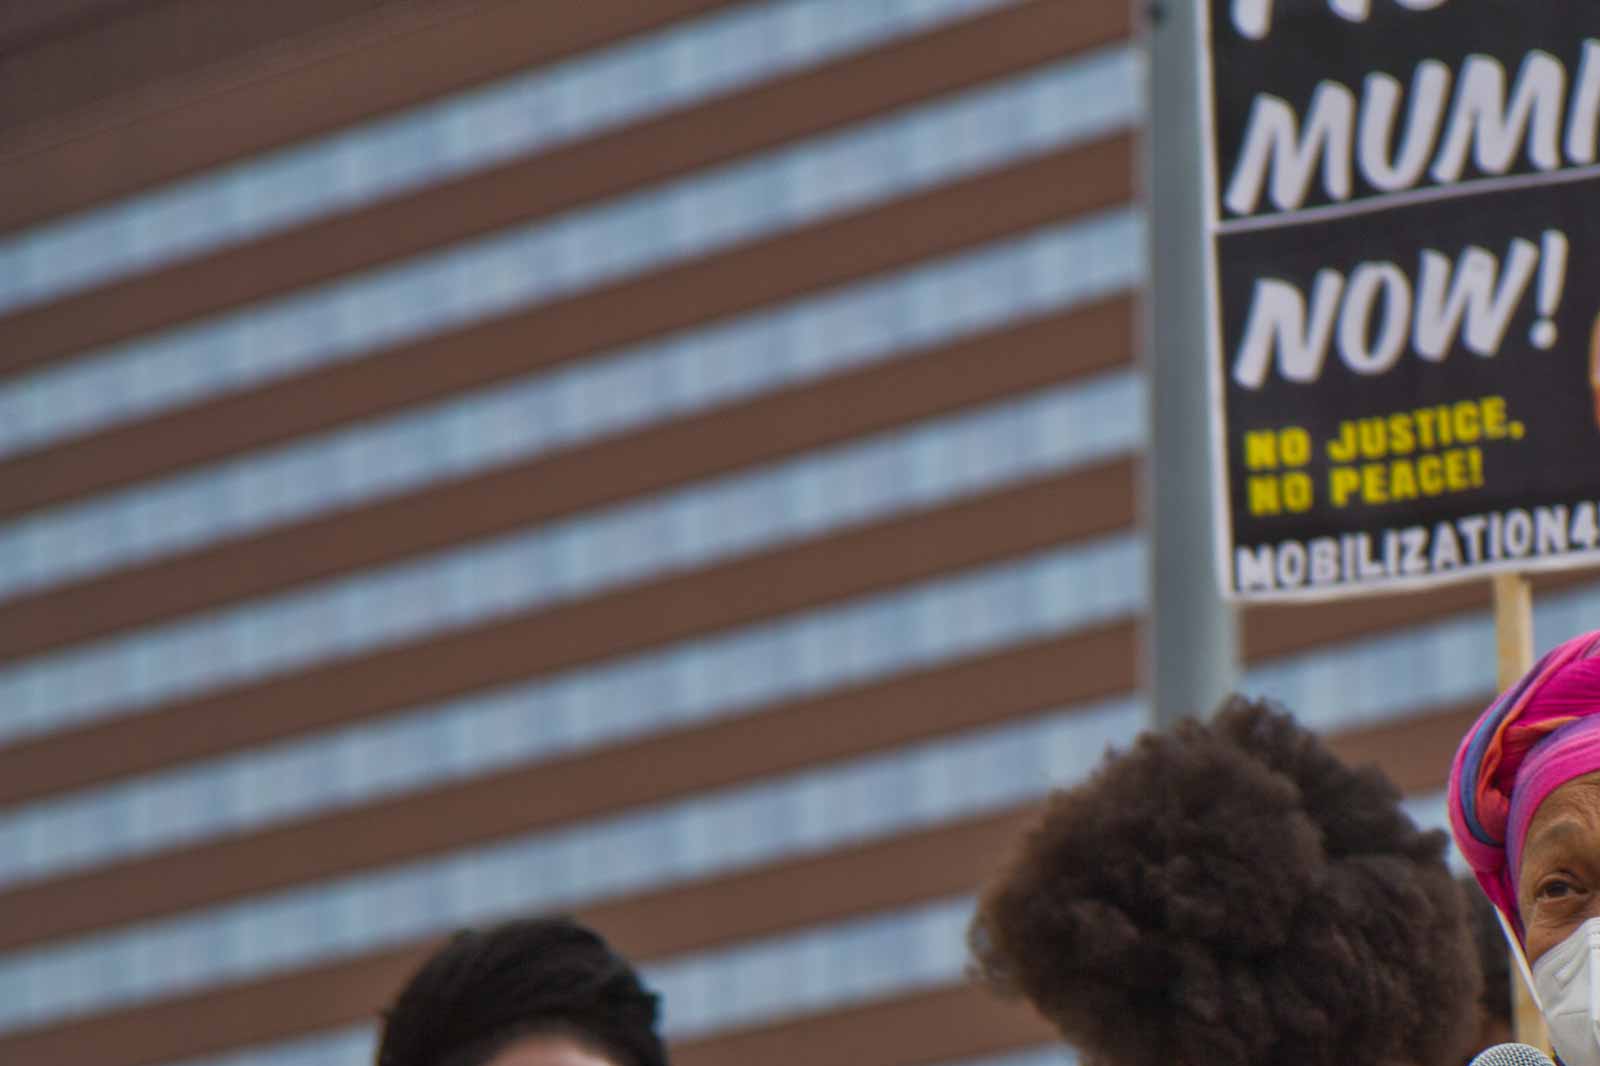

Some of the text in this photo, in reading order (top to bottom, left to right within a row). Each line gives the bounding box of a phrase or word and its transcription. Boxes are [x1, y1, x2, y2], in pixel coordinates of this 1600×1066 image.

[1234, 229, 1569, 390] NOW!
[1244, 426, 1311, 471] NO
[1246, 448, 1484, 517] NO PEACE!
